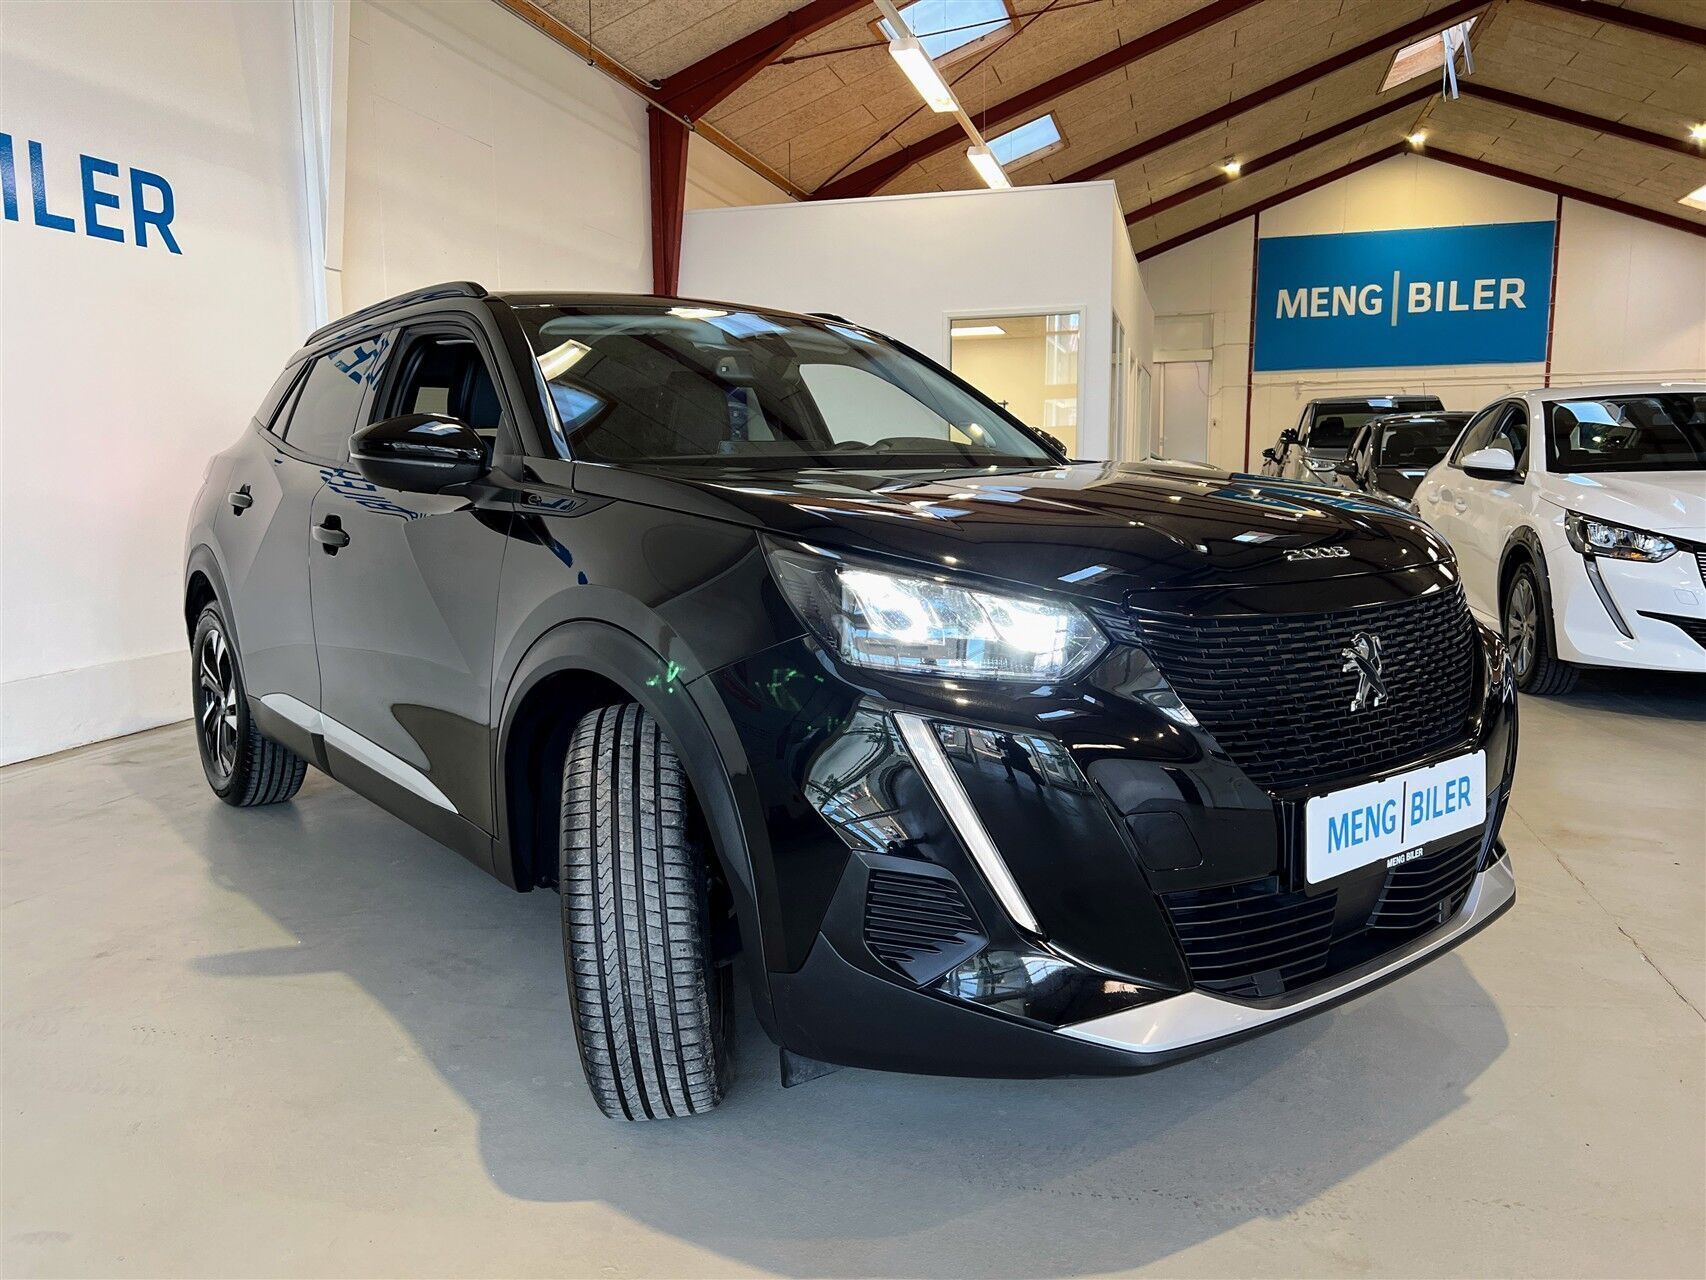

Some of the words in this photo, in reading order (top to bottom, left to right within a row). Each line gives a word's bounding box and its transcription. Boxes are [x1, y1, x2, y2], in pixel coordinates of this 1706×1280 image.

[1275, 283, 1383, 319] MENG
[1407, 277, 1527, 313] BILER
[1327, 798, 1397, 854] MENG
[1410, 775, 1472, 826] BILER
[1386, 853, 1406, 868] MENG
[1406, 847, 1424, 862] BILER
